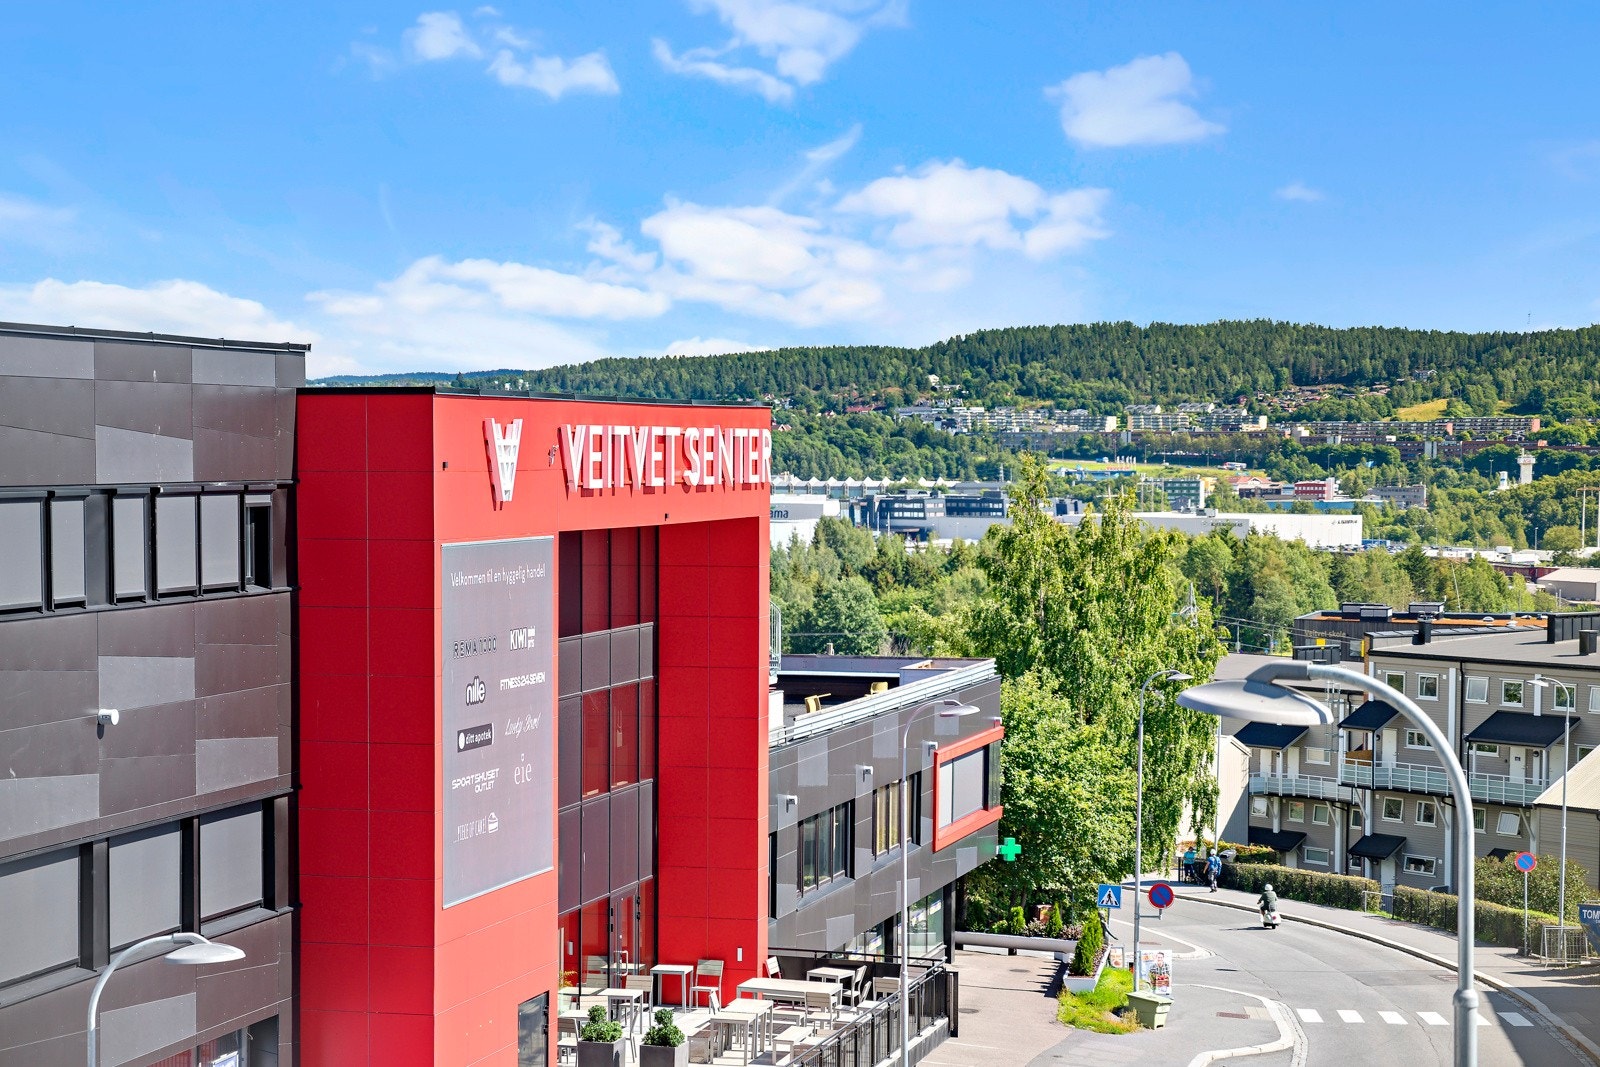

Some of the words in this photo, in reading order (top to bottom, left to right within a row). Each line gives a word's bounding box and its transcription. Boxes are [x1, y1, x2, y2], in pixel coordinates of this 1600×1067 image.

[559, 424, 681, 493] VEITVET
[682, 425, 771, 487] SENTER
[451, 571, 486, 587] Velkommen
[493, 572, 501, 582] en
[502, 565, 526, 585] hyggelig
[526, 563, 546, 578] handel
[453, 638, 478, 659] REMA
[478, 636, 497, 655] 1000
[510, 627, 527, 651] KIWI
[465, 675, 486, 706] nille
[465, 732, 475, 745] ditt
[474, 728, 492, 744] apotek
[451, 767, 500, 790] SPORTSHUSET
[514, 753, 532, 785] eie
[474, 780, 495, 794] OUTLET
